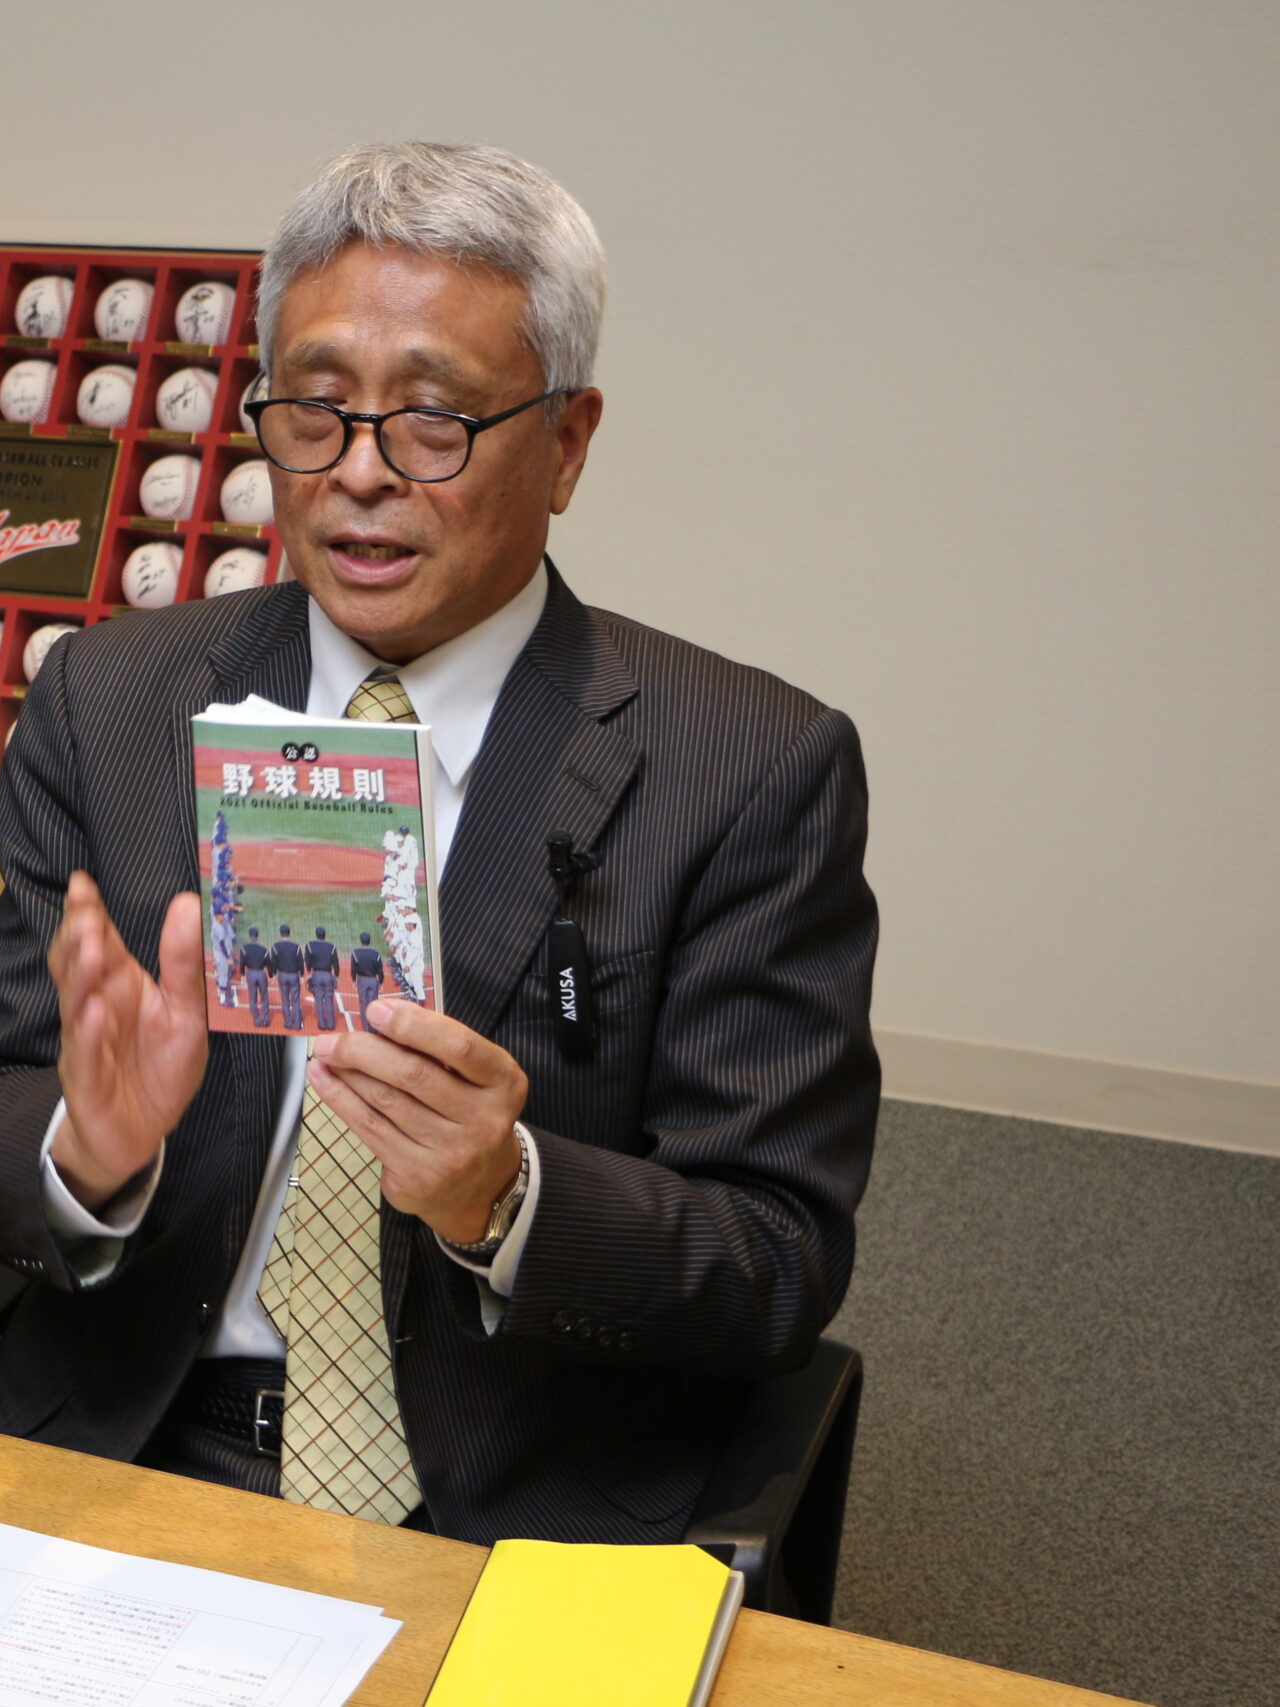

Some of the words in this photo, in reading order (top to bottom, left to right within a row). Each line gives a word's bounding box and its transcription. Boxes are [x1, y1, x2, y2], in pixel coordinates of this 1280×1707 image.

[50, 451, 101, 470] CLASSIC
[222, 762, 385, 803] 野球規則
[251, 799, 299, 810] Official
[303, 801, 356, 813] Baseball
[360, 803, 394, 814] Rules
